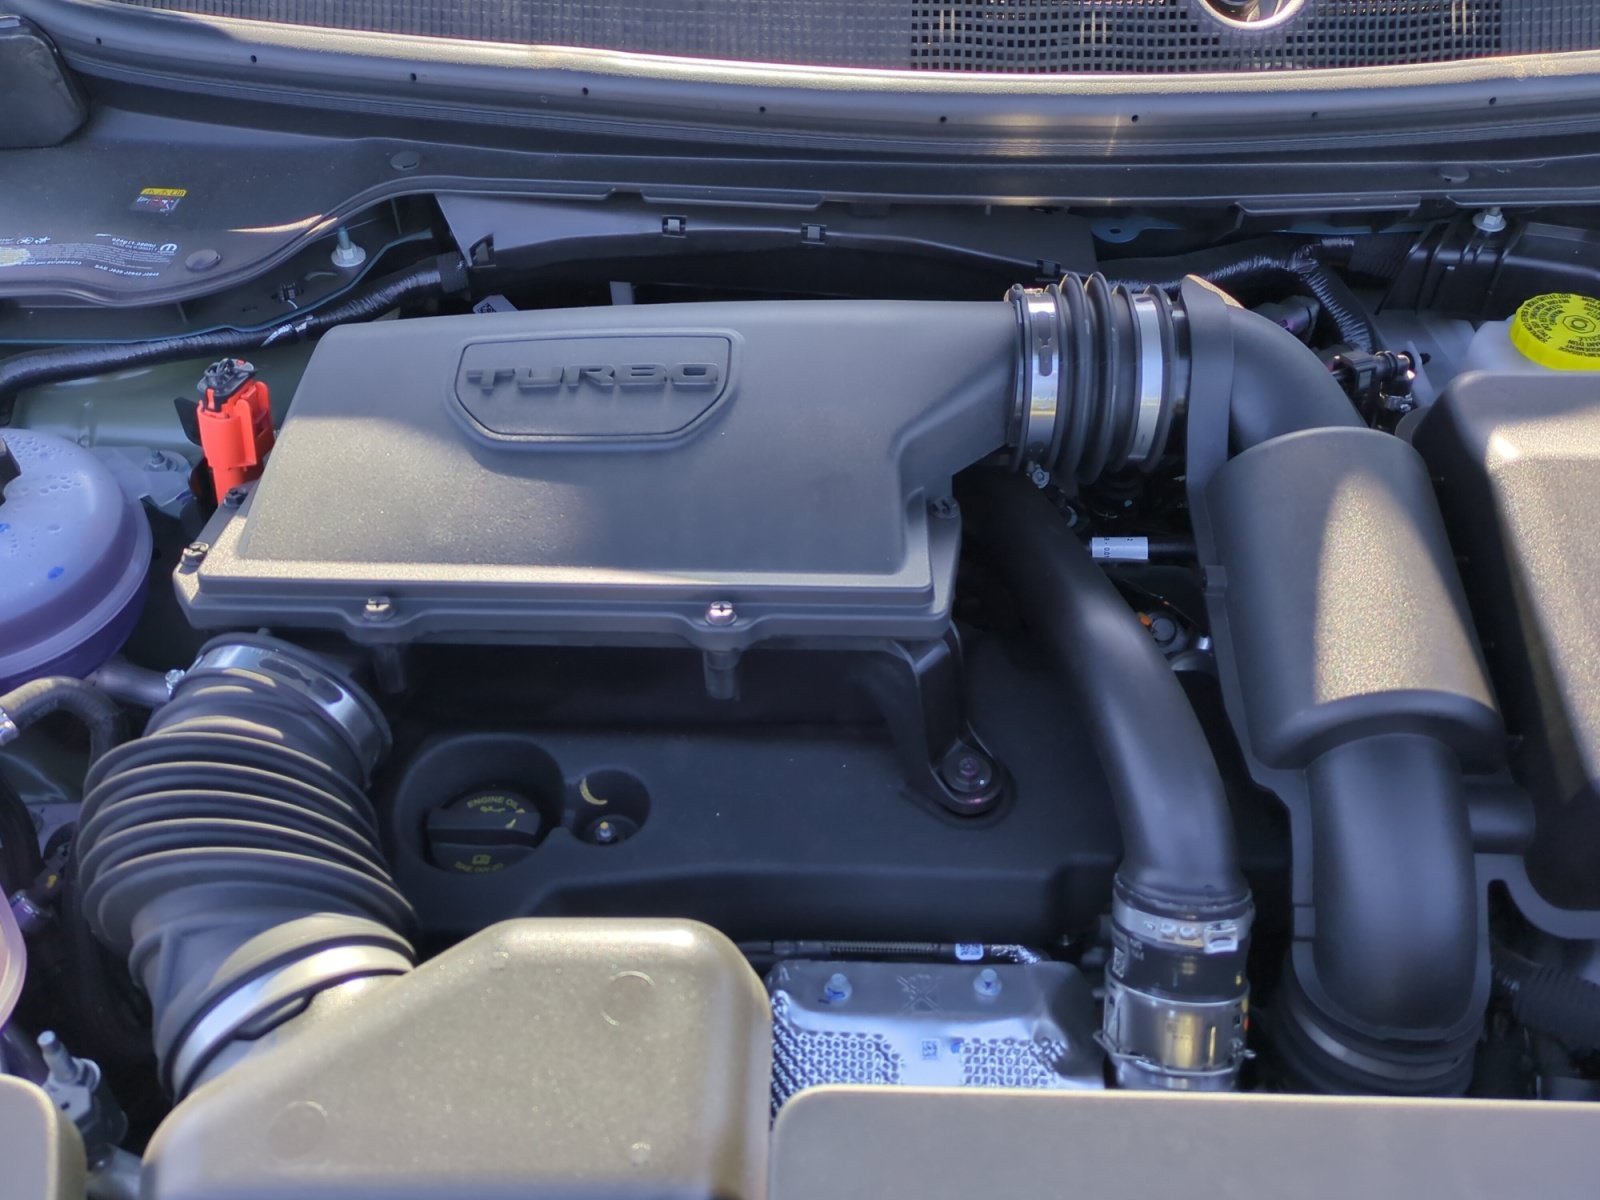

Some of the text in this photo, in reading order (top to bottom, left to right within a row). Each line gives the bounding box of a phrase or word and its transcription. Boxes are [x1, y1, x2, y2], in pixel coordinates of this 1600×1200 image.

[466, 363, 720, 394] TURBO
[467, 796, 518, 810] ENGINE OIL
